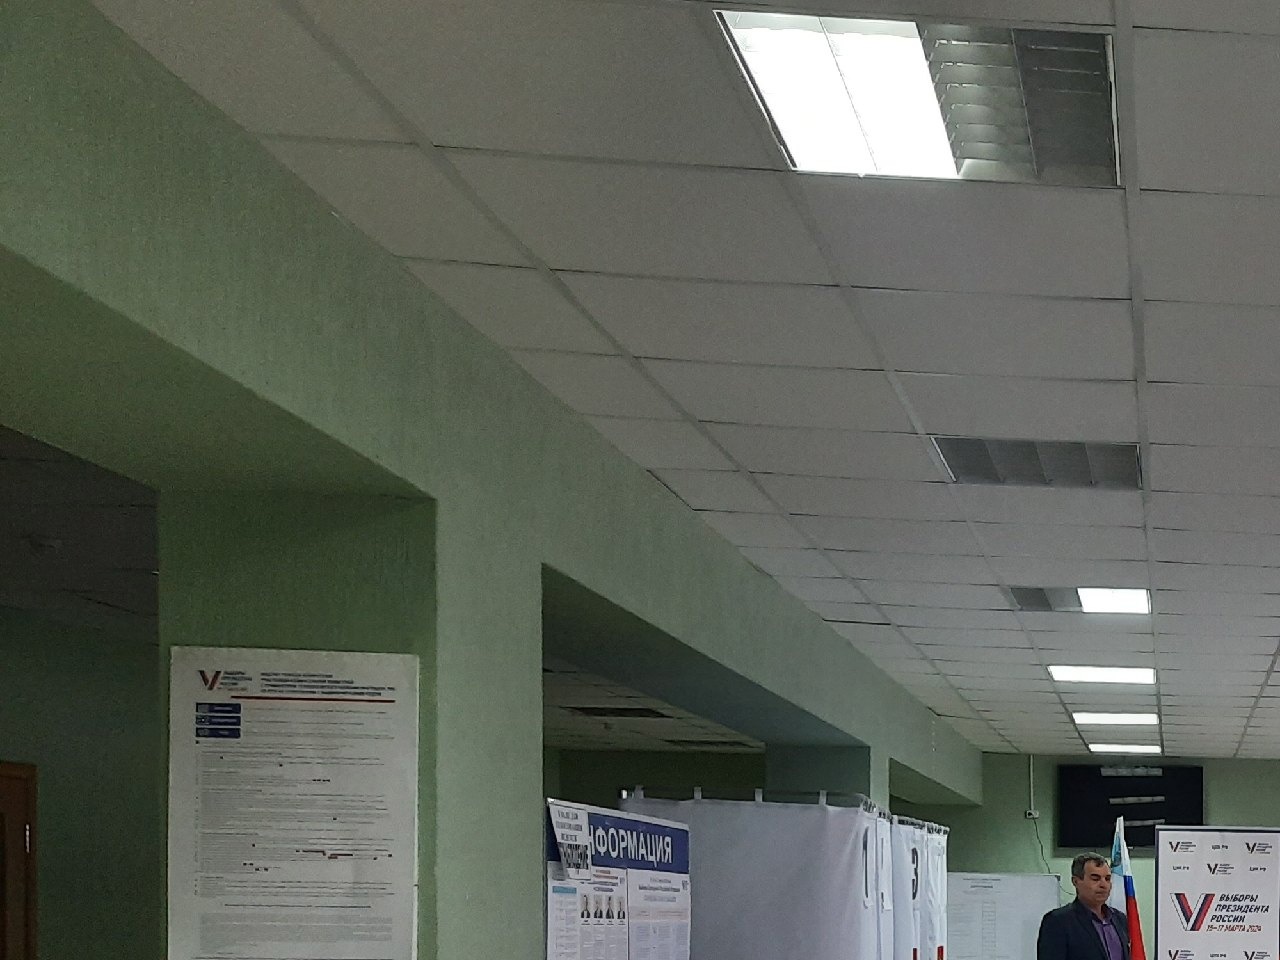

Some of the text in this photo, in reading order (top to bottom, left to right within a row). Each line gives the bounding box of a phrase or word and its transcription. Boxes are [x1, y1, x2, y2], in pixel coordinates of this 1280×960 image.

[588, 824, 673, 868] НФОРМАЦИЯ
[1218, 893, 1259, 903] ВЫБОРЫ
[1214, 903, 1270, 914] ПРЕЗИДЕНТА
[1210, 914, 1246, 923] РОССИИ
